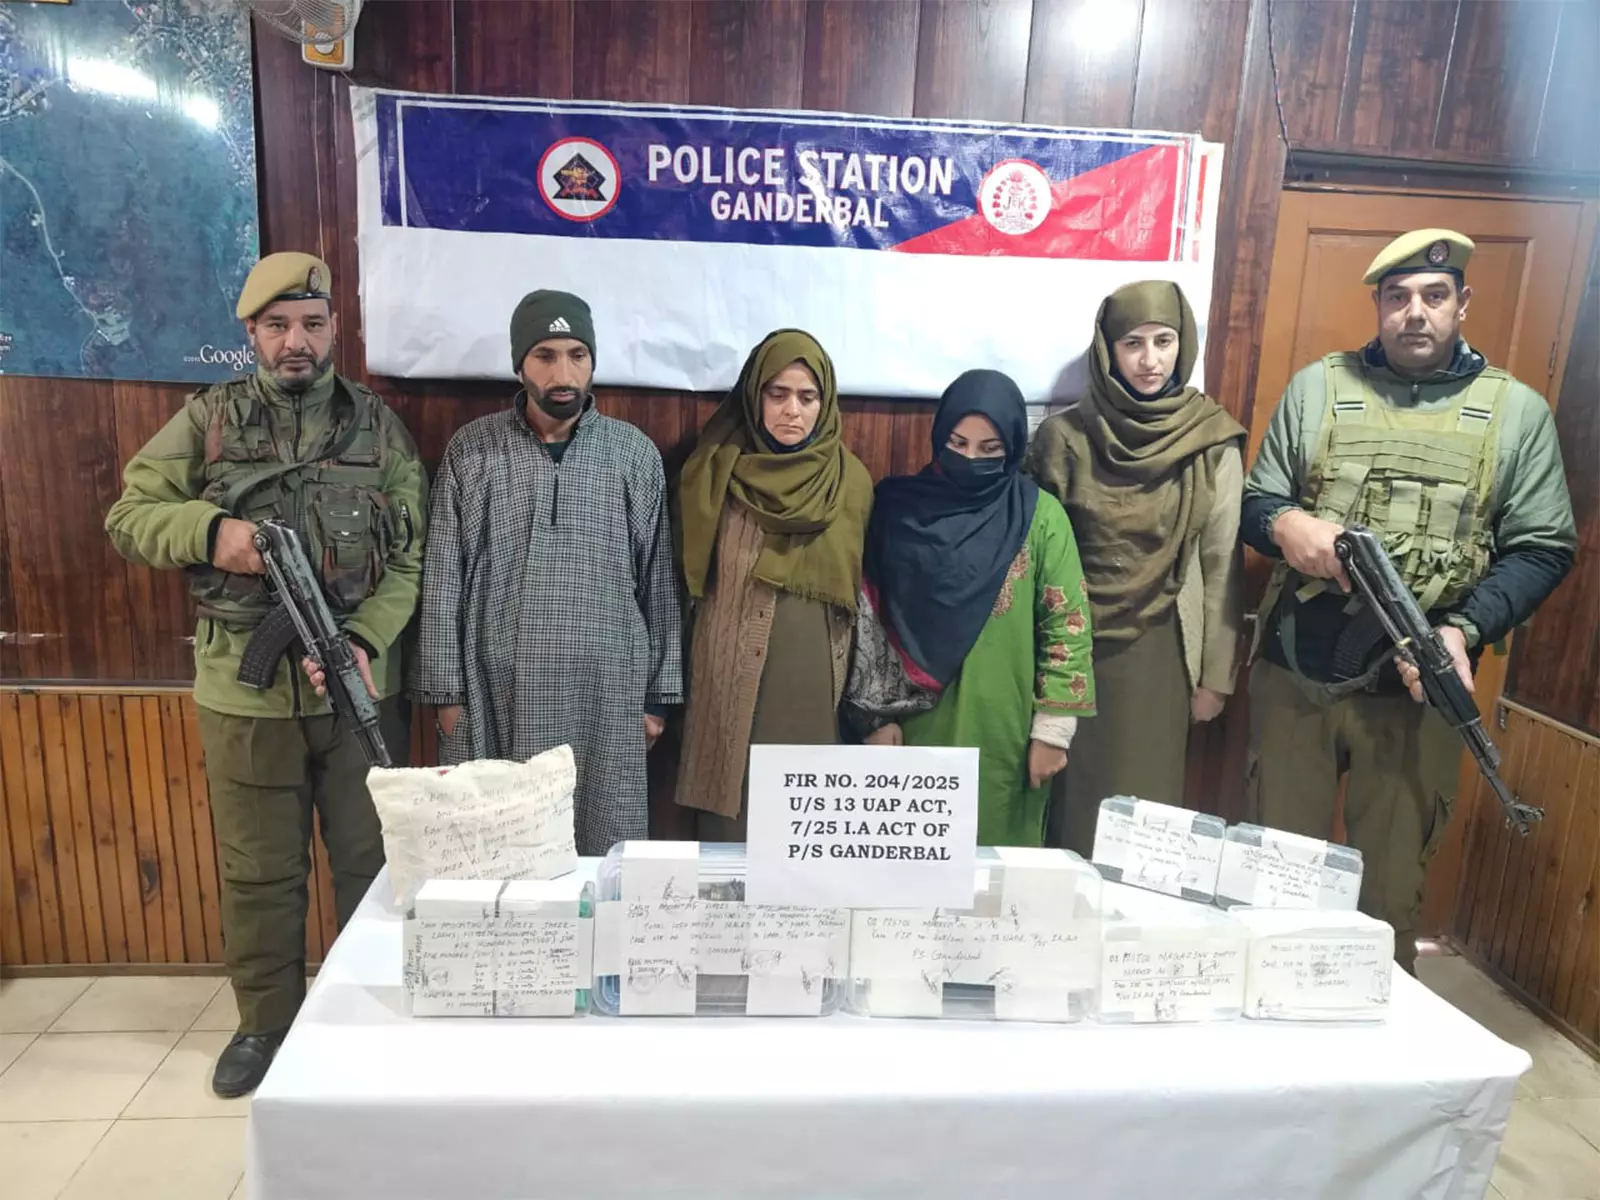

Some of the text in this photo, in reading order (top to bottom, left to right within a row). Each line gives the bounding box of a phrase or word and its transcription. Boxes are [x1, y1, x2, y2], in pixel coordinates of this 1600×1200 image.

[648, 144, 955, 195] POLICE STATION
[711, 190, 889, 228] GANDERBAL
[200, 343, 255, 371] Google
[783, 773, 960, 791] FIR NO. 204/2025
[789, 797, 953, 816] U/S 13 UAP ACT,
[791, 820, 951, 837] 7/25 I.A ACT OF
[788, 844, 951, 861] P/S GANDERBAL
